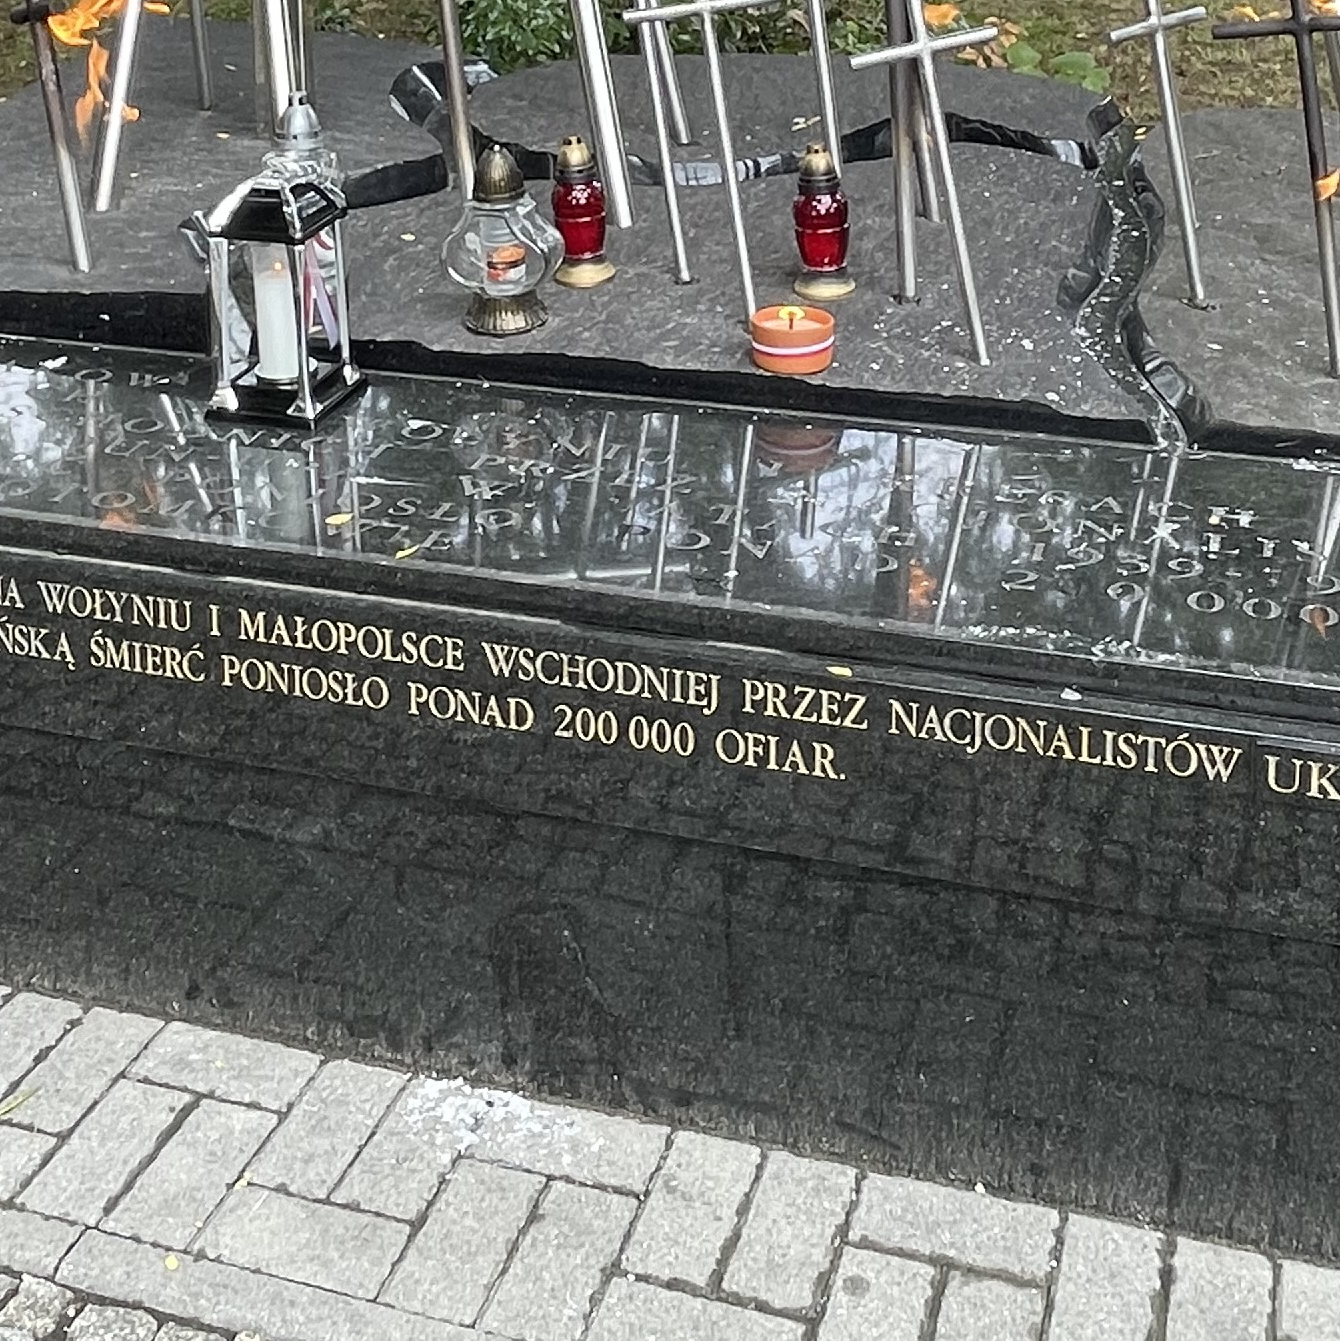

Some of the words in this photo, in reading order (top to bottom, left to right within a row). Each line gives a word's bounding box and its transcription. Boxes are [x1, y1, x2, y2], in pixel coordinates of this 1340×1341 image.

[36, 580, 192, 636] WOŁYNIU
[208, 604, 222, 637] I
[238, 608, 465, 671] MAŁOPOLSCE
[480, 641, 722, 716] WSCHODNIEJ
[741, 678, 868, 730] PRZEZ
[887, 698, 1244, 783] NACJONALISTÓW
[90, 628, 206, 682] ŚMIERĆ
[220, 654, 390, 710] PONIOSŁO
[406, 681, 535, 732] PONAD
[715, 728, 846, 780] OFIAR.
